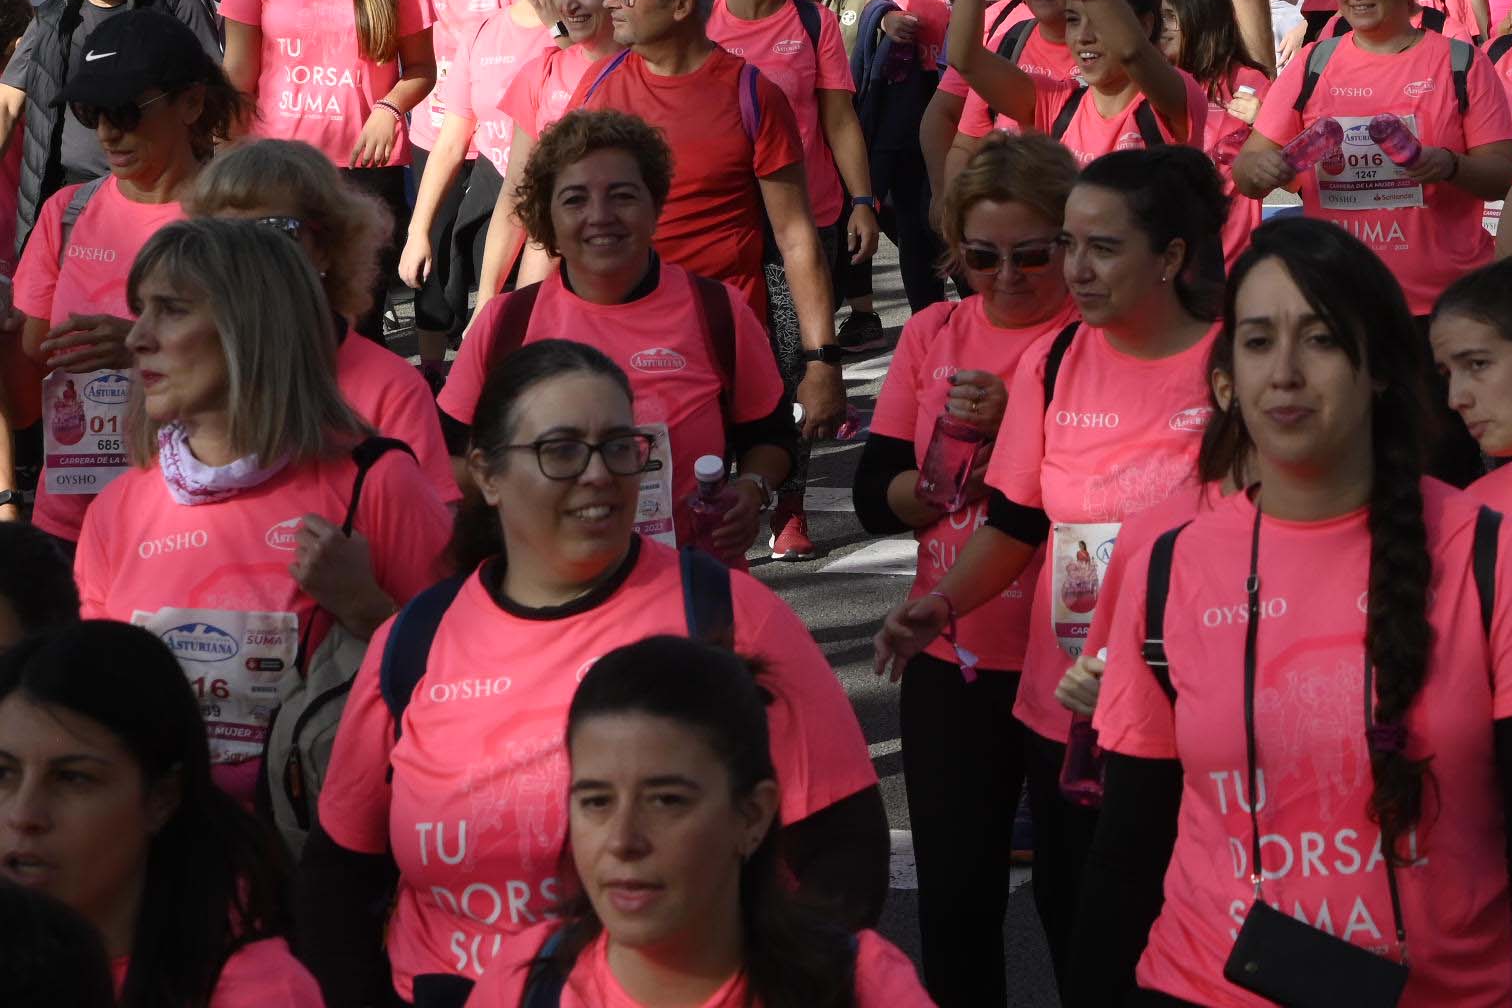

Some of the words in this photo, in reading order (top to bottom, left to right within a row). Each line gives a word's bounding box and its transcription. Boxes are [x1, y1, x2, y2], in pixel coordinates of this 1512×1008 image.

[277, 37, 301, 58] TU
[279, 90, 341, 114] SUMA
[1349, 153, 1383, 167] 016
[1356, 170, 1377, 179] 1247
[88, 385, 129, 398] ASTURIA
[90, 415, 118, 433] 01
[1056, 410, 1120, 429] OYSHO
[97, 440, 120, 451] 685
[59, 457, 95, 465] CARRERA
[57, 474, 96, 485] OYSHO
[139, 529, 208, 560] OYSHO
[246, 634, 283, 646] SUMA
[191, 676, 230, 699] 16
[429, 676, 512, 703] OYSHO
[214, 727, 252, 738] MUJER
[1209, 768, 1267, 815] TU
[415, 820, 467, 866] TU
[431, 876, 562, 926] DORS
[1229, 895, 1382, 942] SMA
